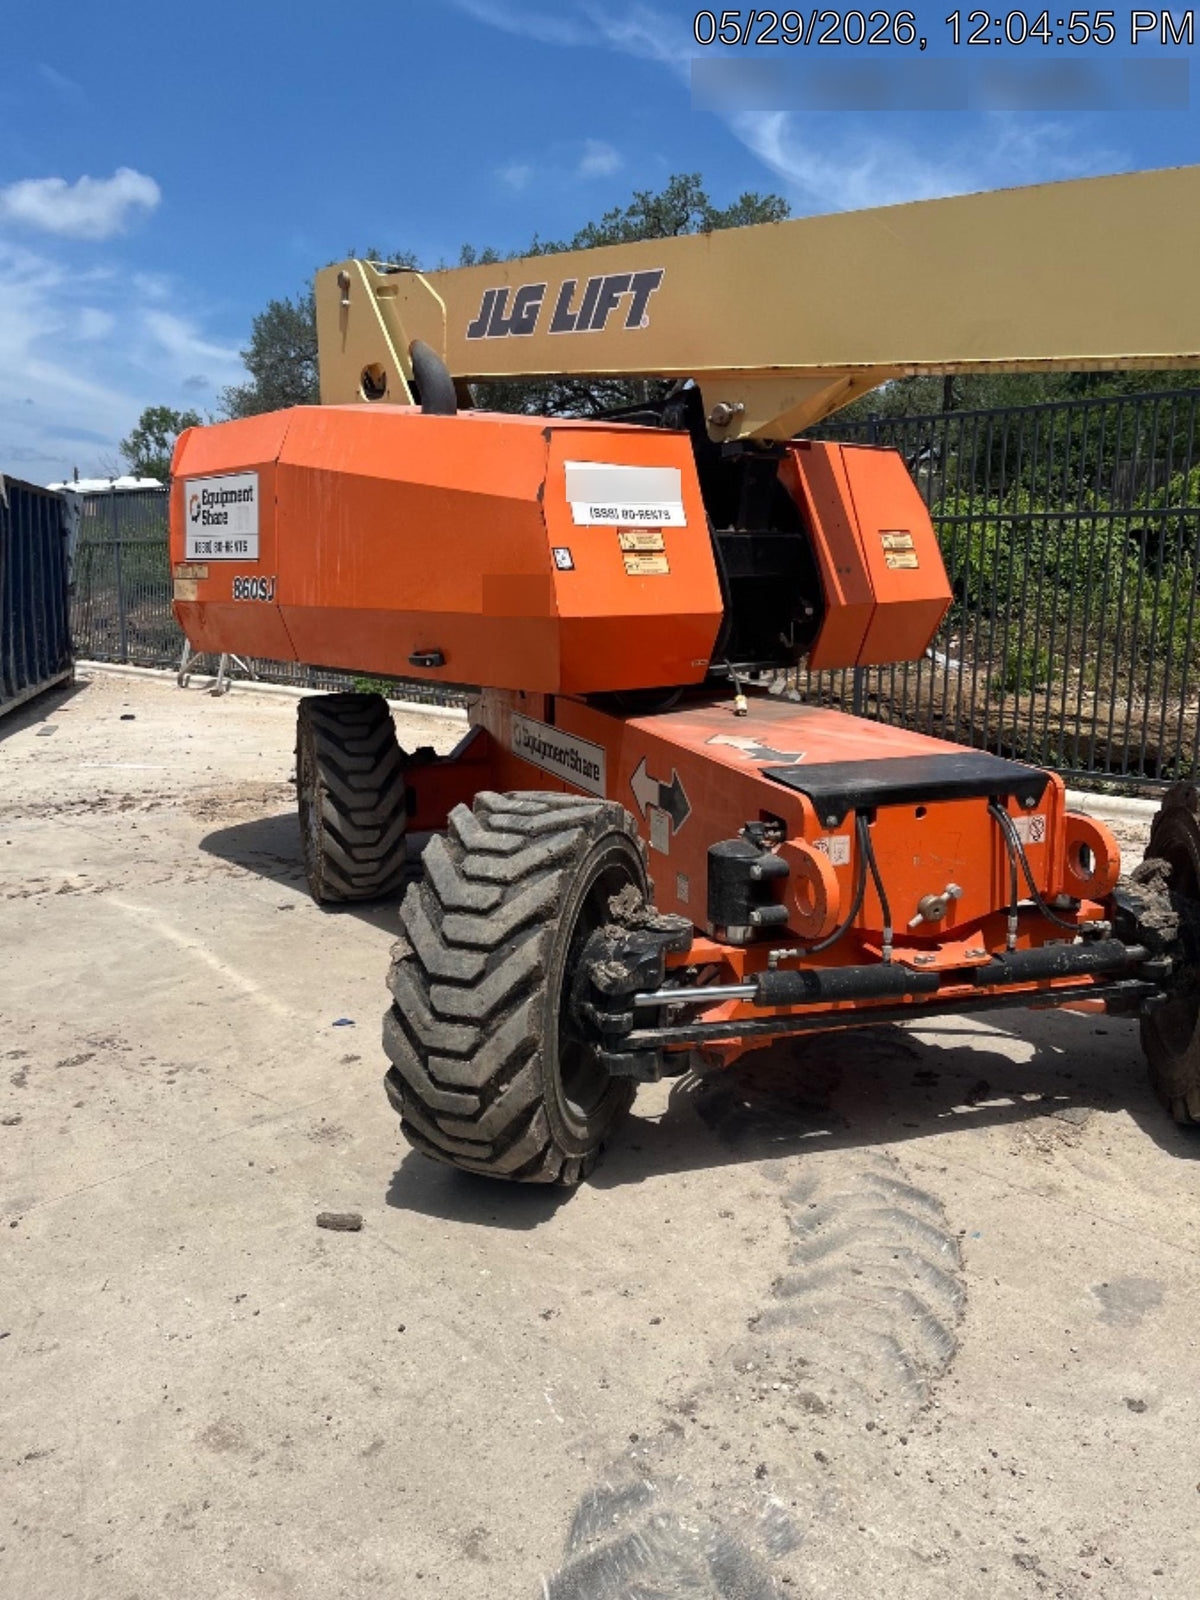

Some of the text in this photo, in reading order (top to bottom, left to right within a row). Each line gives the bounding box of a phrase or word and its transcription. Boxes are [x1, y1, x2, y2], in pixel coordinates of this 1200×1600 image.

[466, 268, 665, 340] JLG LIFT
[202, 485, 254, 509] Equipment
[202, 510, 228, 526] Share
[233, 576, 276, 602] 860SJ
[522, 727, 600, 781] EquipmentShare
